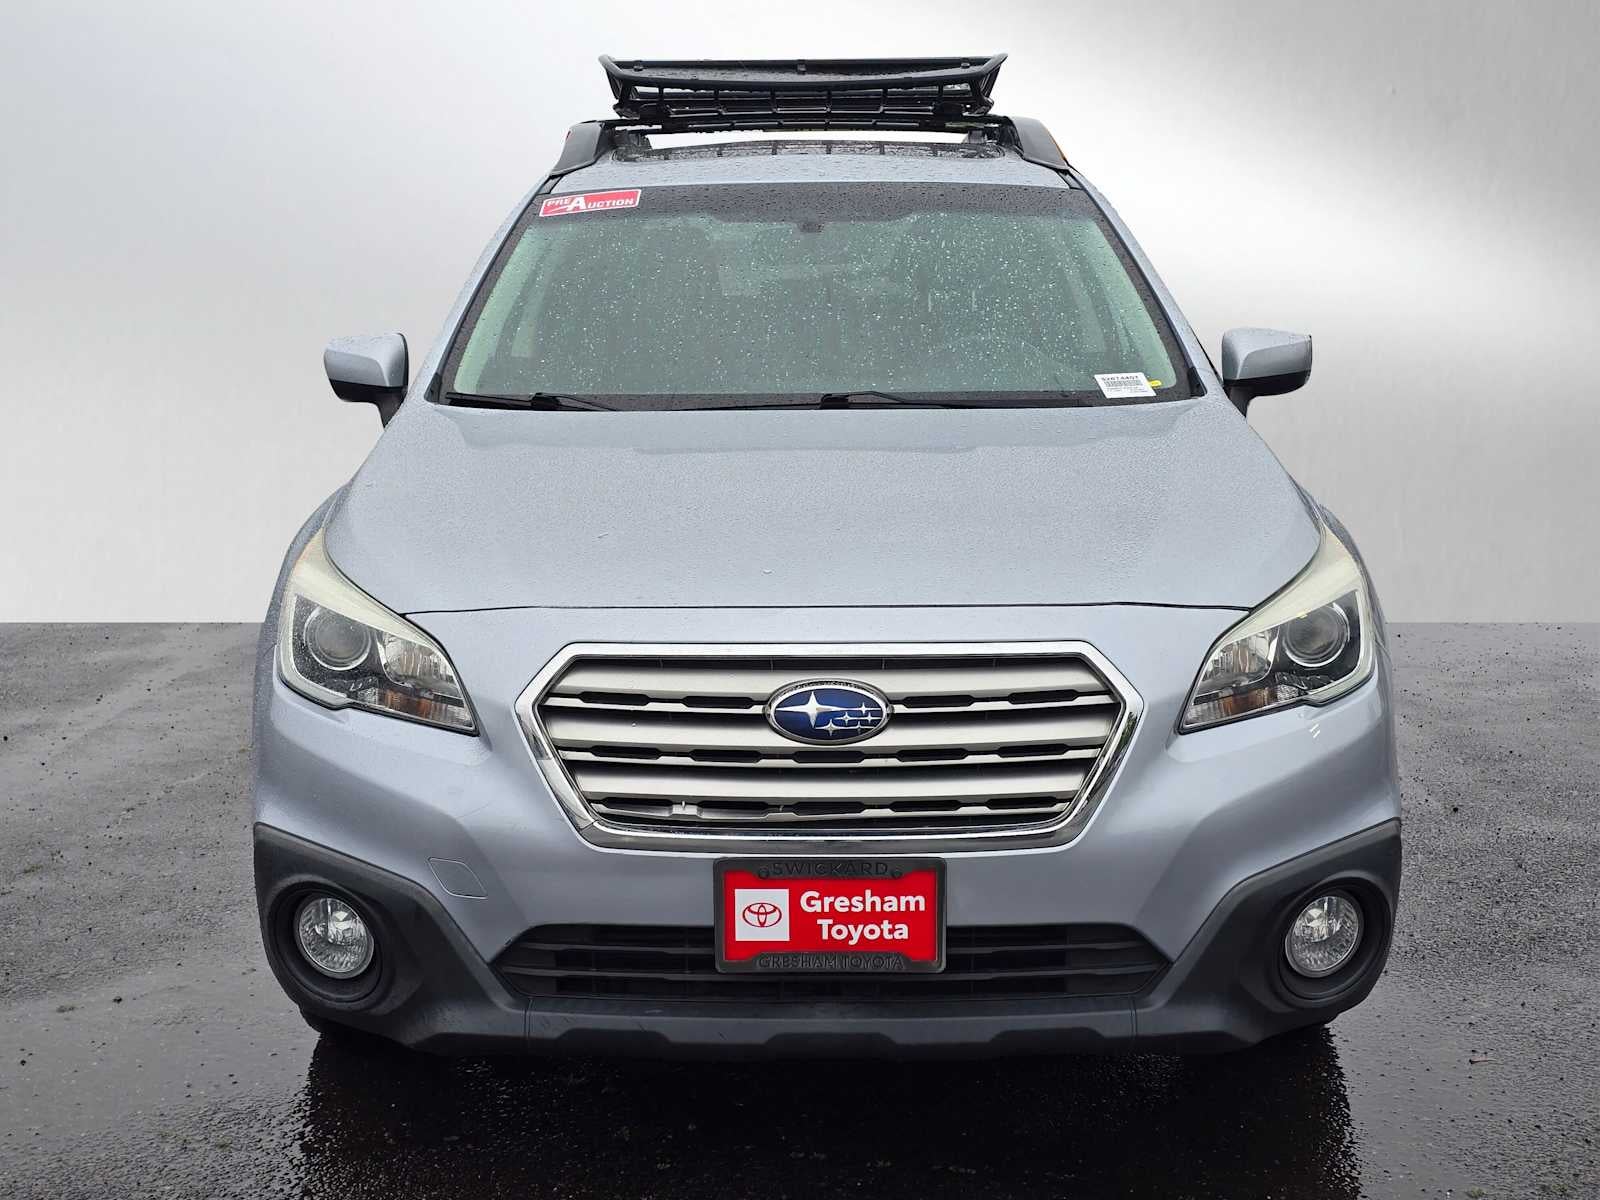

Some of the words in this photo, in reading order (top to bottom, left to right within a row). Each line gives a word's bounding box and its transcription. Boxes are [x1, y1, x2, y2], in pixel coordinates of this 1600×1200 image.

[547, 197, 572, 207] PRE
[566, 196, 635, 211] AUCTION
[772, 862, 888, 876] SWICKARD
[800, 889, 926, 913] Gresham
[817, 919, 909, 945] Toyota
[758, 955, 838, 969] GRESHAM
[840, 955, 905, 969] TOYOTA
